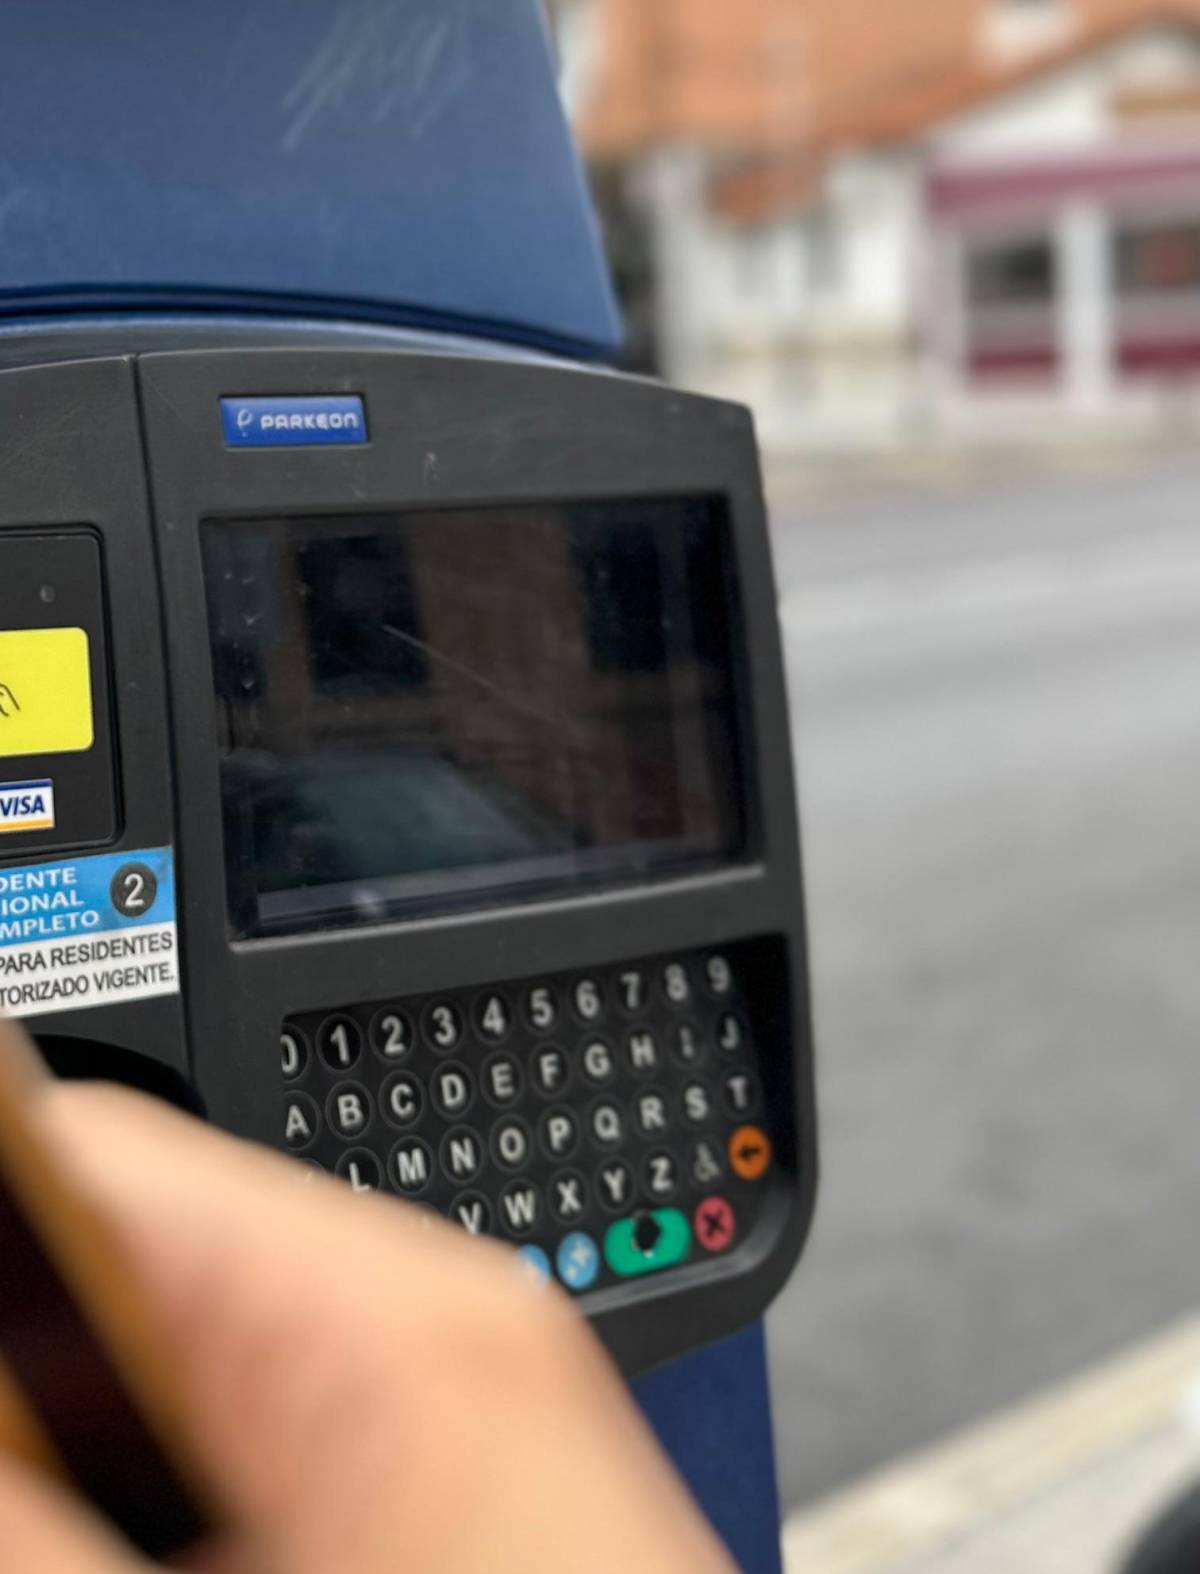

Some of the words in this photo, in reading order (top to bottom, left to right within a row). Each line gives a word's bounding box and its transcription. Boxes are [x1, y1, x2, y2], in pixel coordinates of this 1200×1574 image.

[260, 411, 358, 431] PARKEON
[123, 872, 145, 908] 2
[50, 930, 174, 967] RESIDENTES
[92, 961, 175, 991] VIGENTE.
[621, 972, 640, 1009] 7
[665, 965, 689, 1002] 8
[707, 957, 731, 994] 9
[483, 998, 505, 1035] 4
[531, 989, 554, 1027] 5
[576, 981, 600, 1019] 6
[382, 1016, 405, 1055] 2
[433, 1007, 456, 1046] 3
[720, 1018, 740, 1050] J
[330, 1025, 350, 1063] 1
[584, 1044, 611, 1078] G
[631, 1036, 655, 1067] H
[491, 1063, 514, 1097] E
[540, 1053, 558, 1086] F
[390, 1083, 414, 1118] C
[441, 1073, 465, 1108] D
[685, 1086, 708, 1120] S
[728, 1076, 747, 1108] T
[285, 1105, 309, 1138] A
[337, 1094, 363, 1128] B
[594, 1107, 621, 1140] Q
[640, 1096, 665, 1129] R
[499, 1127, 525, 1162] O
[548, 1117, 571, 1150] P
[397, 1148, 426, 1183] M
[450, 1138, 475, 1172] N
[349, 1161, 371, 1194] L
[603, 1169, 624, 1201] Y
[651, 1157, 672, 1192] Z
[504, 1191, 535, 1225] W
[558, 1180, 581, 1213] X
[458, 1201, 482, 1235] V
